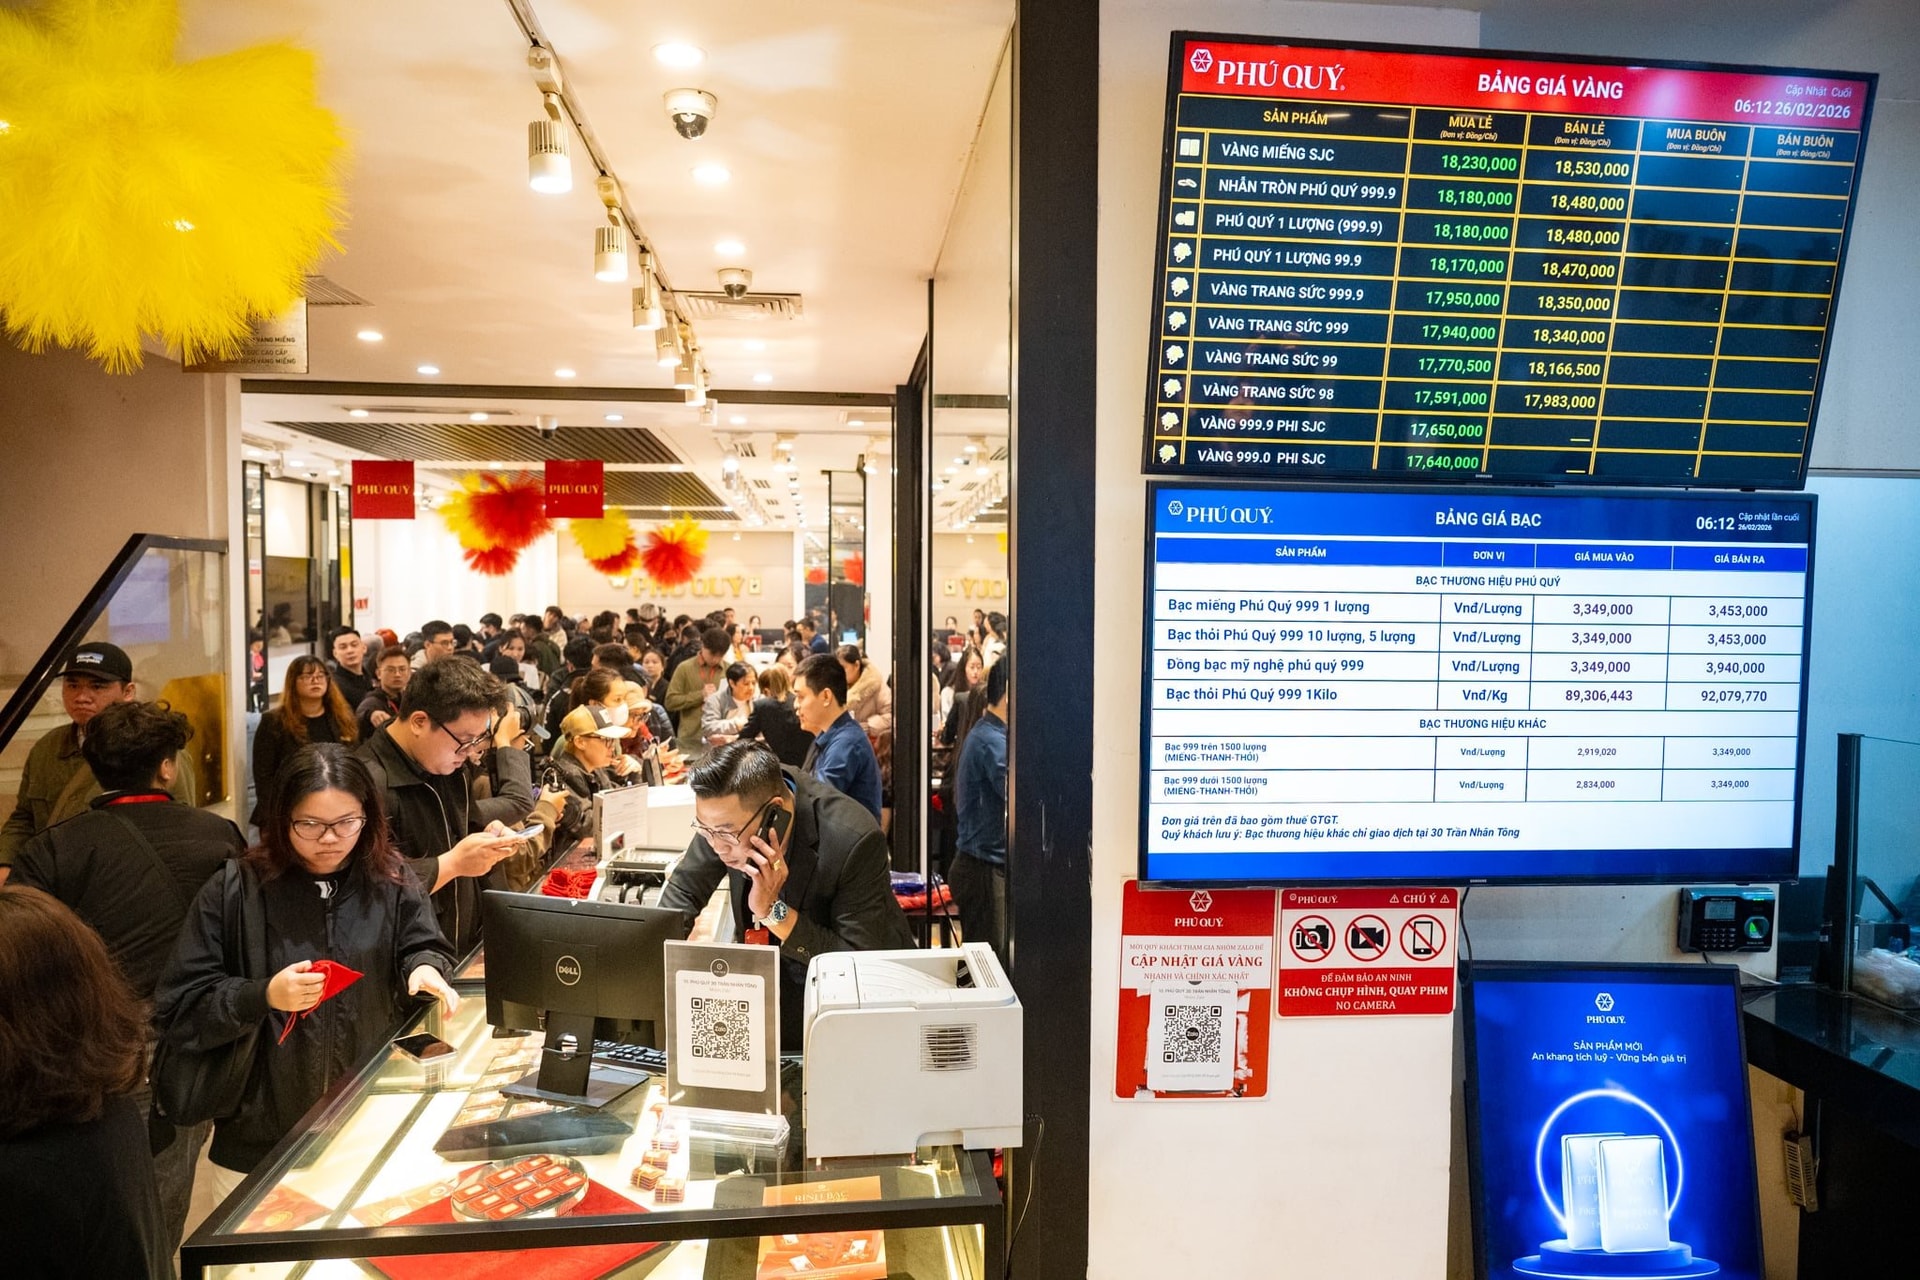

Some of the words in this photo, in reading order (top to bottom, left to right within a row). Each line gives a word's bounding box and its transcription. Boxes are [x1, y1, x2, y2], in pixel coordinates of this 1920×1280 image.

[1217, 61, 1279, 86] PHÚ
[1282, 64, 1345, 90] QUÝ
[1478, 70, 1530, 94] BẢNG
[1535, 75, 1566, 96] GIÁ
[1572, 77, 1623, 99] VÀNG
[1785, 84, 1802, 97] Cập
[1805, 86, 1826, 97] Nhật
[1831, 87, 1852, 98] Cuối
[1263, 108, 1288, 123] SẢN
[1734, 99, 1772, 114] 06:12
[1775, 101, 1851, 118] 26/02/2026
[1449, 115, 1475, 128] MUA
[1478, 115, 1493, 129] LẺ
[1564, 121, 1589, 134] BÁN
[1591, 121, 1605, 135] LẺ
[1666, 128, 1692, 139] MUA
[1695, 128, 1726, 141] BUÔN
[1777, 132, 1801, 145] BÁN
[1803, 135, 1834, 147] BUÔN
[1222, 142, 1259, 157] VÀNG
[1262, 144, 1305, 160] MIẾNG
[1309, 148, 1334, 161] SJC
[1442, 155, 1517, 172] 18,230,000
[1556, 161, 1629, 177] 18,530,000
[1260, 180, 1297, 194] TRÒN
[1300, 182, 1327, 196] PHÚ
[1330, 183, 1358, 198] QUÝ
[1361, 186, 1396, 199] 999.9
[1438, 190, 1512, 206] 18,180,000
[1551, 195, 1624, 211] 18,480,000
[1216, 213, 1244, 227] PHÚ
[1247, 214, 1275, 229] QUÝ
[1278, 217, 1284, 229] 1
[1289, 218, 1334, 232] LƯỢNG
[1338, 219, 1382, 236] (999.9)
[1434, 224, 1508, 240] 18,180,000
[1547, 229, 1620, 245] 18,480,000
[1430, 258, 1504, 274] 18,170,000
[1542, 263, 1615, 278] 18,470,000
[1211, 281, 1247, 296] VÀNG
[1251, 285, 1295, 298] TRANG
[1298, 285, 1326, 299] SỨC
[1329, 288, 1364, 300] 999.9
[1427, 292, 1500, 307] 17,950,000
[1538, 296, 1610, 311] 18,350,000
[1423, 325, 1495, 341] 17,940,000
[1534, 329, 1605, 344] 18,340,000
[1419, 358, 1491, 373] 17,770,500
[1415, 391, 1487, 406] 17,591,000
[1525, 395, 1596, 409] 17,983,000
[1200, 416, 1236, 430] VÀNG
[1239, 419, 1273, 431] 999.9
[1277, 420, 1298, 431] PHI
[1301, 421, 1326, 432] SJC
[1411, 423, 1483, 438] 17,650,000
[1407, 455, 1479, 470] 17,640,000
[1187, 506, 1227, 522] PHÚ
[1231, 507, 1272, 523] QUÝ
[1436, 508, 1478, 525] BẢNG
[1482, 510, 1507, 526] GIÁ
[1511, 513, 1541, 528] BẠC
[1696, 517, 1735, 530] 06:12
[1276, 546, 1296, 556] SẢN
[1473, 551, 1494, 559] ĐƠN
[1496, 552, 1505, 561] VỊ
[1575, 551, 1590, 561] GIÁ
[1592, 553, 1613, 561] MUA
[1615, 552, 1634, 562] VÀO
[1714, 554, 1730, 563] GIÁ
[1732, 554, 1751, 563] BÁN
[1571, 661, 1630, 674] 3,349,000
[1706, 662, 1765, 675] 3,940,000
[1167, 688, 1190, 701] Bạc
[1194, 687, 1218, 699] thỏi
[1222, 688, 1246, 699] Phú
[1250, 688, 1274, 702] Quý
[1278, 689, 1302, 700] 999
[1307, 689, 1337, 700] 1Kilo
[1462, 690, 1507, 703] Vnđ/Kg
[1566, 690, 1632, 702] 89,306,443
[1701, 691, 1767, 703] 92,079,770
[1162, 816, 1181, 825] Đơn
[1184, 816, 1199, 826] giá
[1202, 816, 1222, 825] trên
[1225, 816, 1237, 825] đã
[1240, 816, 1258, 825] bao
[1310, 815, 1338, 824] GTGT.
[1403, 893, 1426, 903] CHÚ
[1429, 893, 1436, 903] Ý
[1175, 917, 1198, 927] PHÚ
[1199, 917, 1223, 927] QUÝ
[1131, 954, 1157, 968] CẬP
[1161, 954, 1198, 969] NHẬT
[1201, 954, 1224, 967] GIÁ
[1228, 954, 1262, 966] VÀNG
[559, 966, 578, 975] DELL
[1335, 973, 1354, 982] ĐẢM
[1356, 973, 1374, 982] BẢO
[1284, 986, 1322, 997] KHÔNG
[1325, 987, 1354, 998] CHỤP
[1357, 985, 1387, 996] HÌNH,
[1389, 986, 1417, 997] QUAY
[1420, 986, 1448, 995] PHIM
[1336, 1001, 1351, 1010] NO
[1353, 1001, 1396, 1010] CAMERA
[1532, 1052, 1546, 1060] An
[1546, 1053, 1573, 1062] khang
[1576, 1053, 1592, 1061] tích
[1661, 1054, 1675, 1064] giá
[1677, 1055, 1687, 1064] trị
